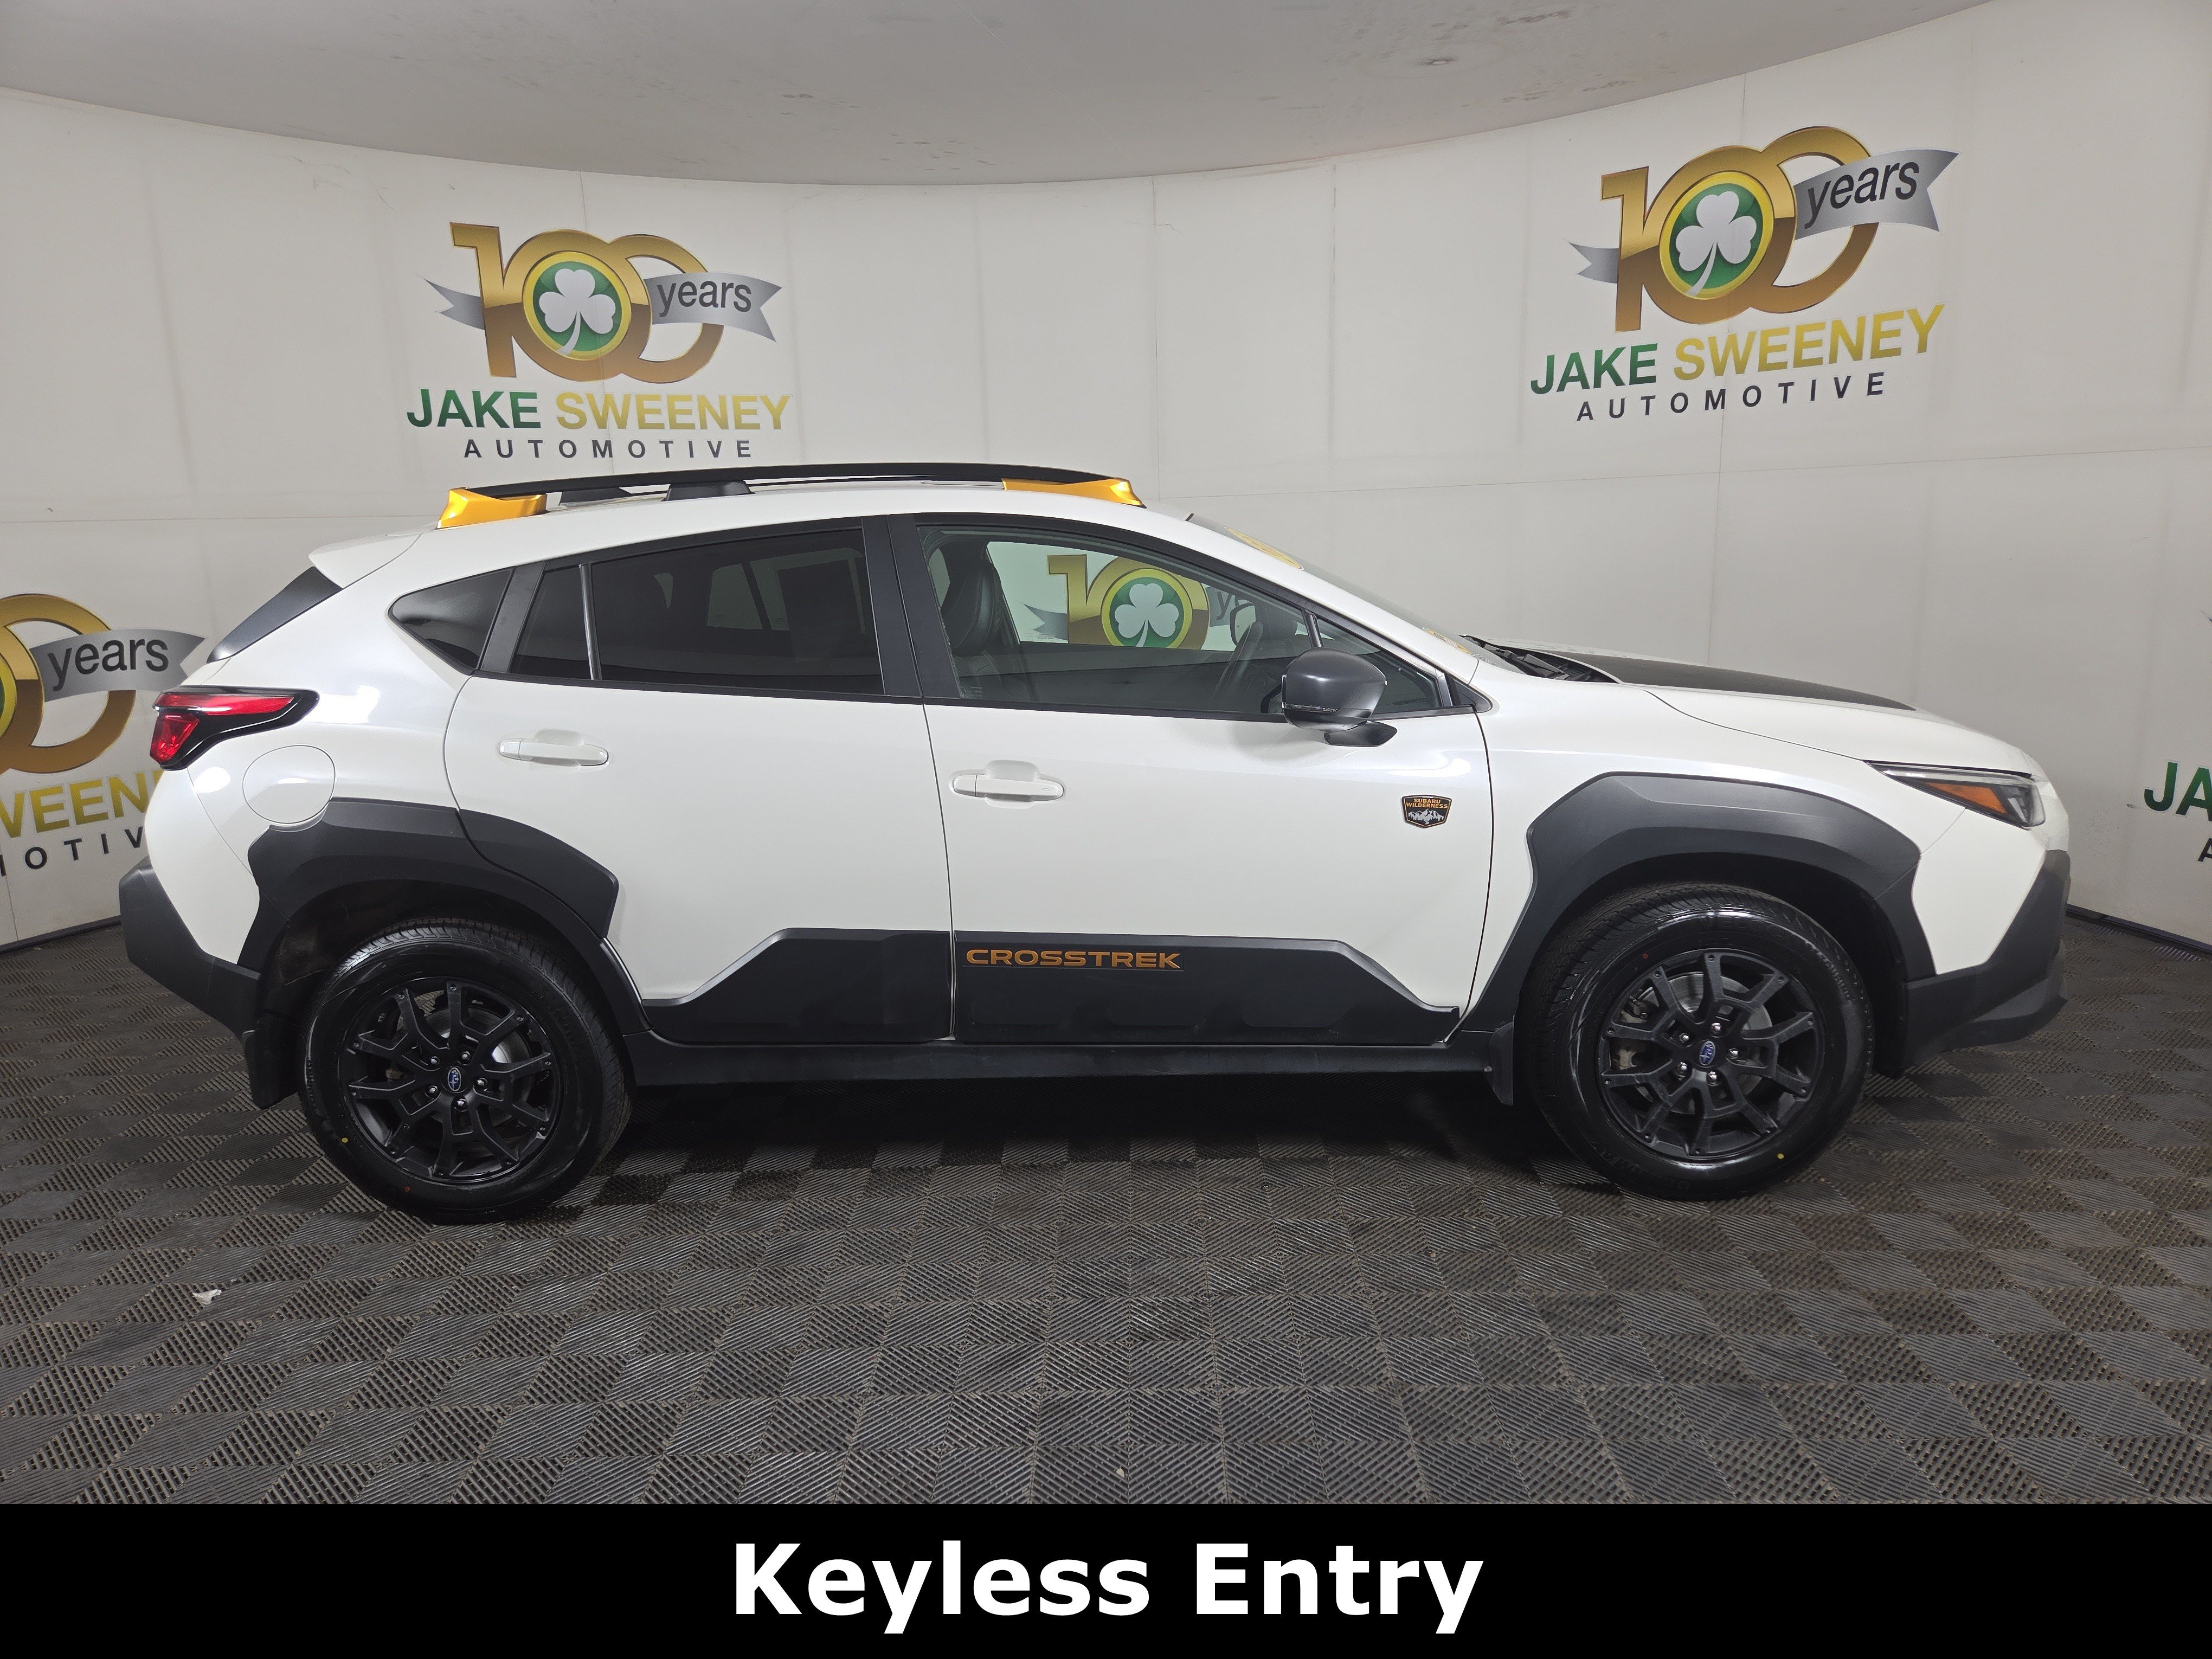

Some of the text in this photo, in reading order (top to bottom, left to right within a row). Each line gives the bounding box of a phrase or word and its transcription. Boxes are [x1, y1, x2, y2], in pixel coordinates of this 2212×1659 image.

[1804, 159, 1920, 229] years
[657, 280, 753, 318] years
[1530, 304, 1945, 394] JAKE SWEENEY
[407, 389, 789, 430] JAKE SWEENEY
[1576, 371, 1885, 421] AUTOMOTIVE
[464, 439, 751, 459] AUTOMOTIVE
[48, 637, 169, 692] years
[966, 949, 1181, 969] CROSSTREK
